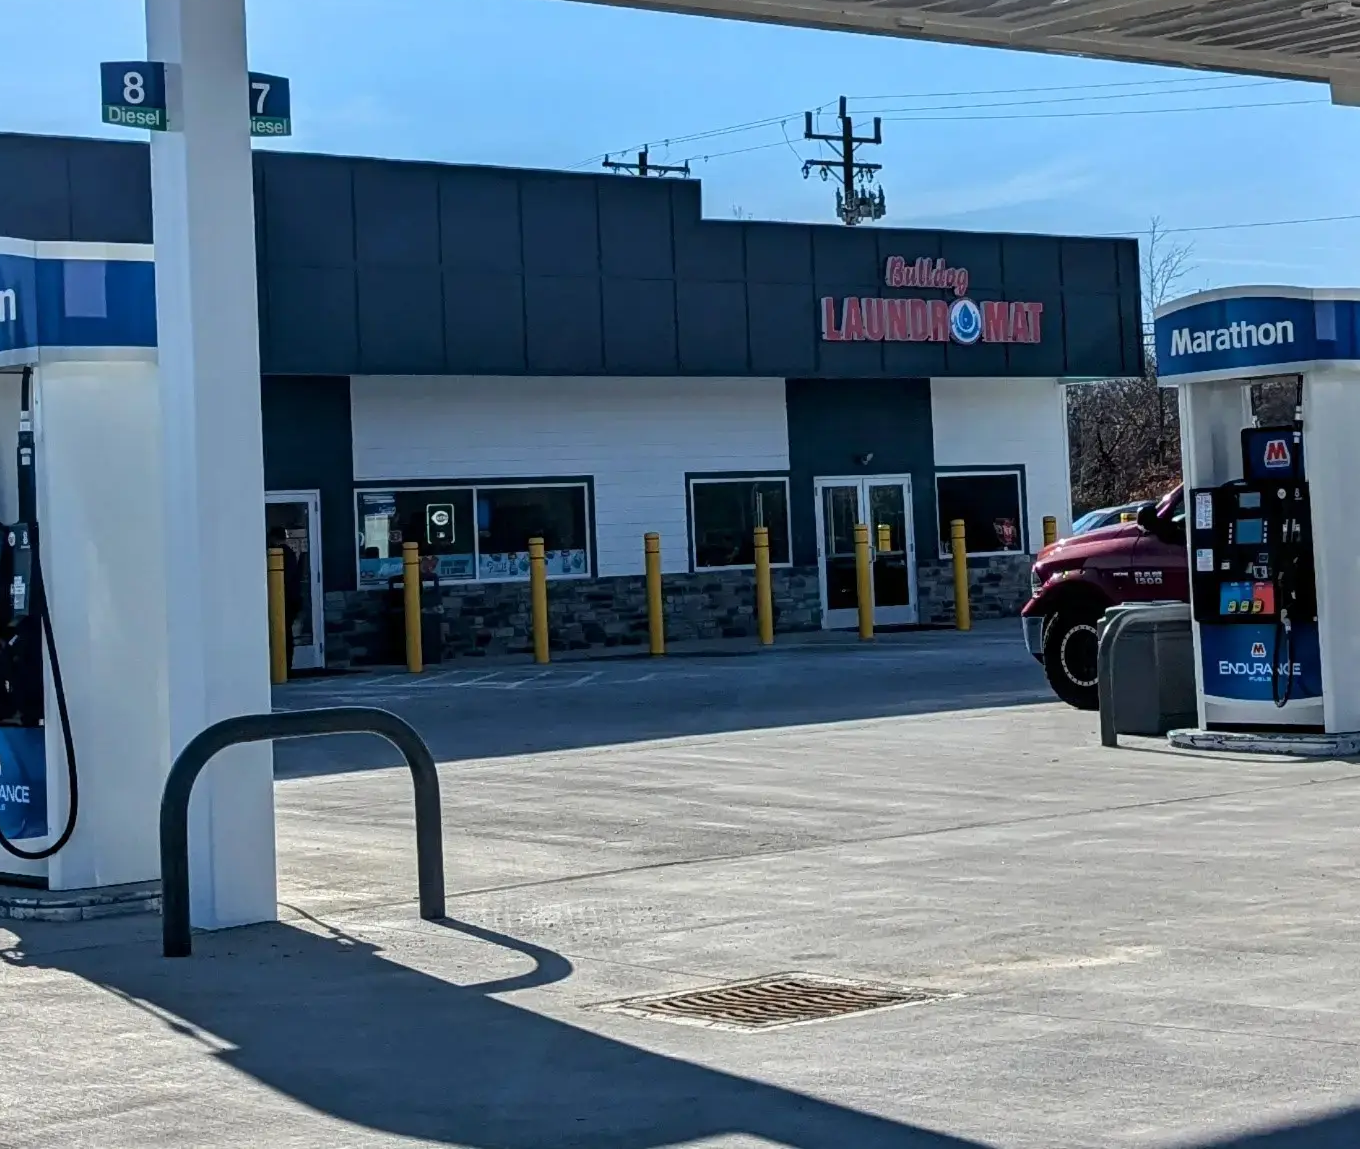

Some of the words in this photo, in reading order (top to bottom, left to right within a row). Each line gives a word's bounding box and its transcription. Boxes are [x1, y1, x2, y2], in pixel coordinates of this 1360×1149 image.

[123, 71, 145, 104] 8
[251, 82, 270, 114] 7
[108, 106, 160, 126] Diesel
[250, 117, 287, 134] iesel
[885, 255, 969, 297] Bulldog
[820, 296, 1043, 346] LAUNDROMAT
[1170, 320, 1295, 357] Marathon
